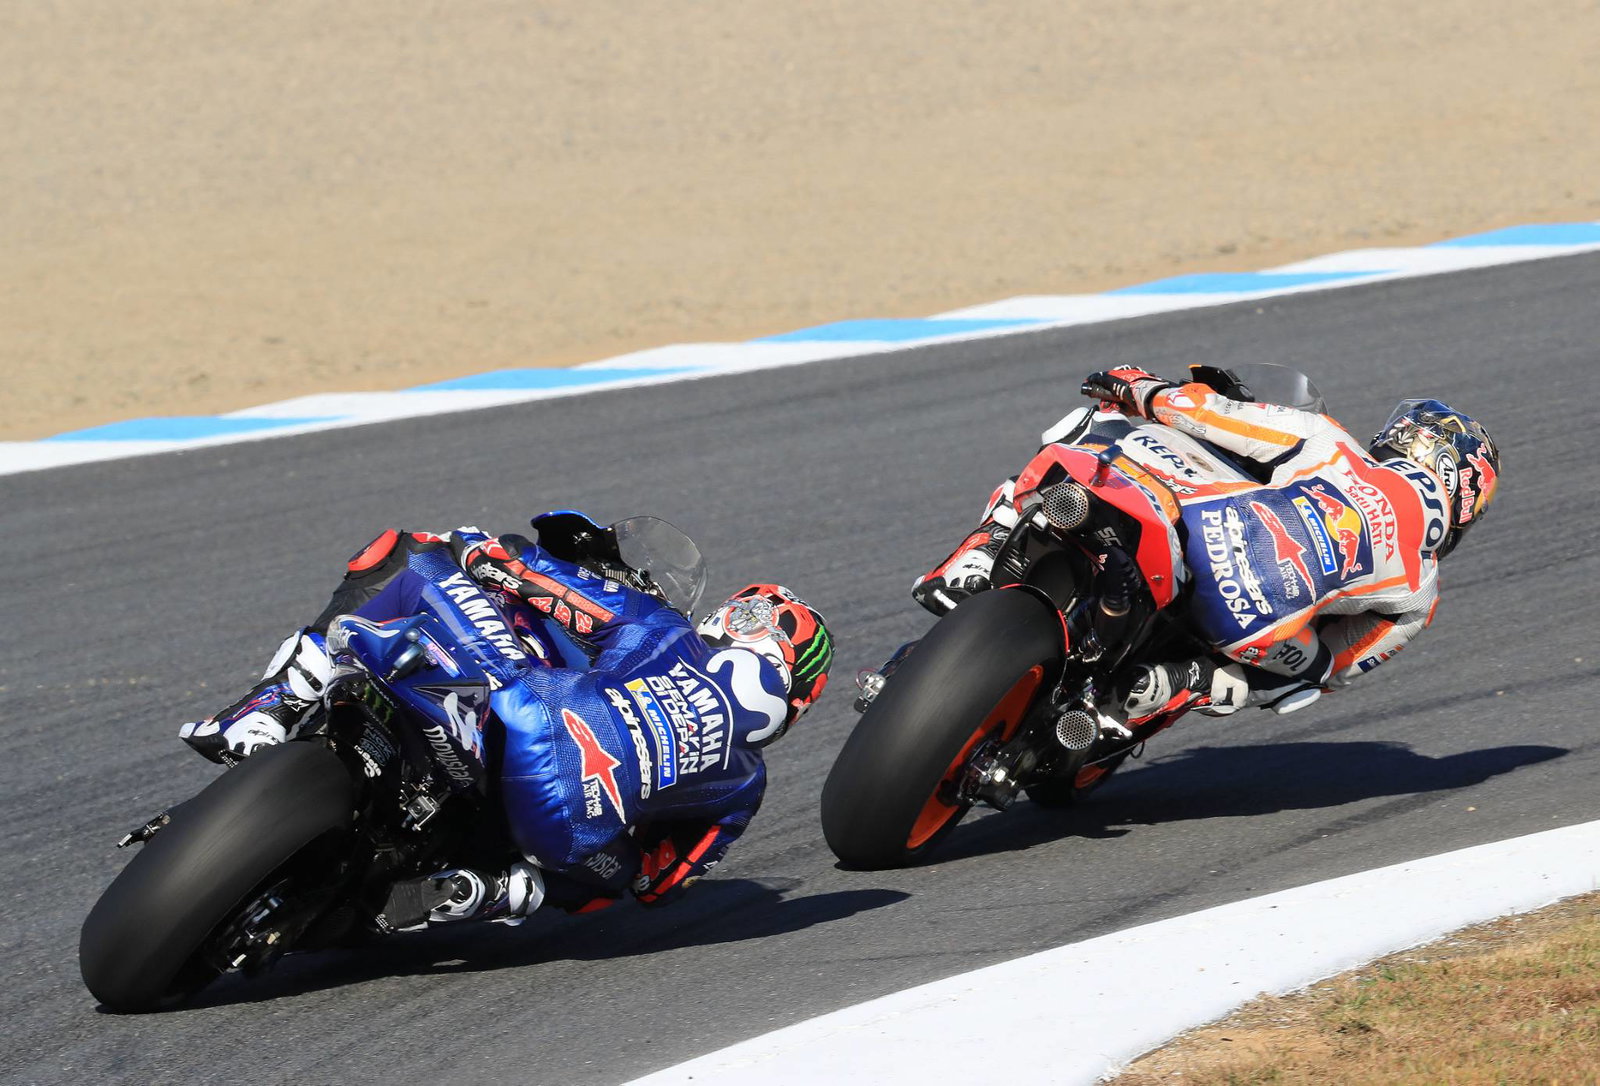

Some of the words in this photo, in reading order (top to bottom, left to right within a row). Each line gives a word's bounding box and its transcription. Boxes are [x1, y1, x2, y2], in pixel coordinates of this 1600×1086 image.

[1201, 510, 1257, 629] PEDROSA
[1224, 507, 1273, 615] alpinestars
[1308, 517, 1332, 566] MICHELIN
[438, 571, 526, 660] YAMAHA
[604, 687, 653, 800] alpinestars
[648, 709, 672, 778] MICHELIN
[668, 662, 724, 772] YAMAHA
